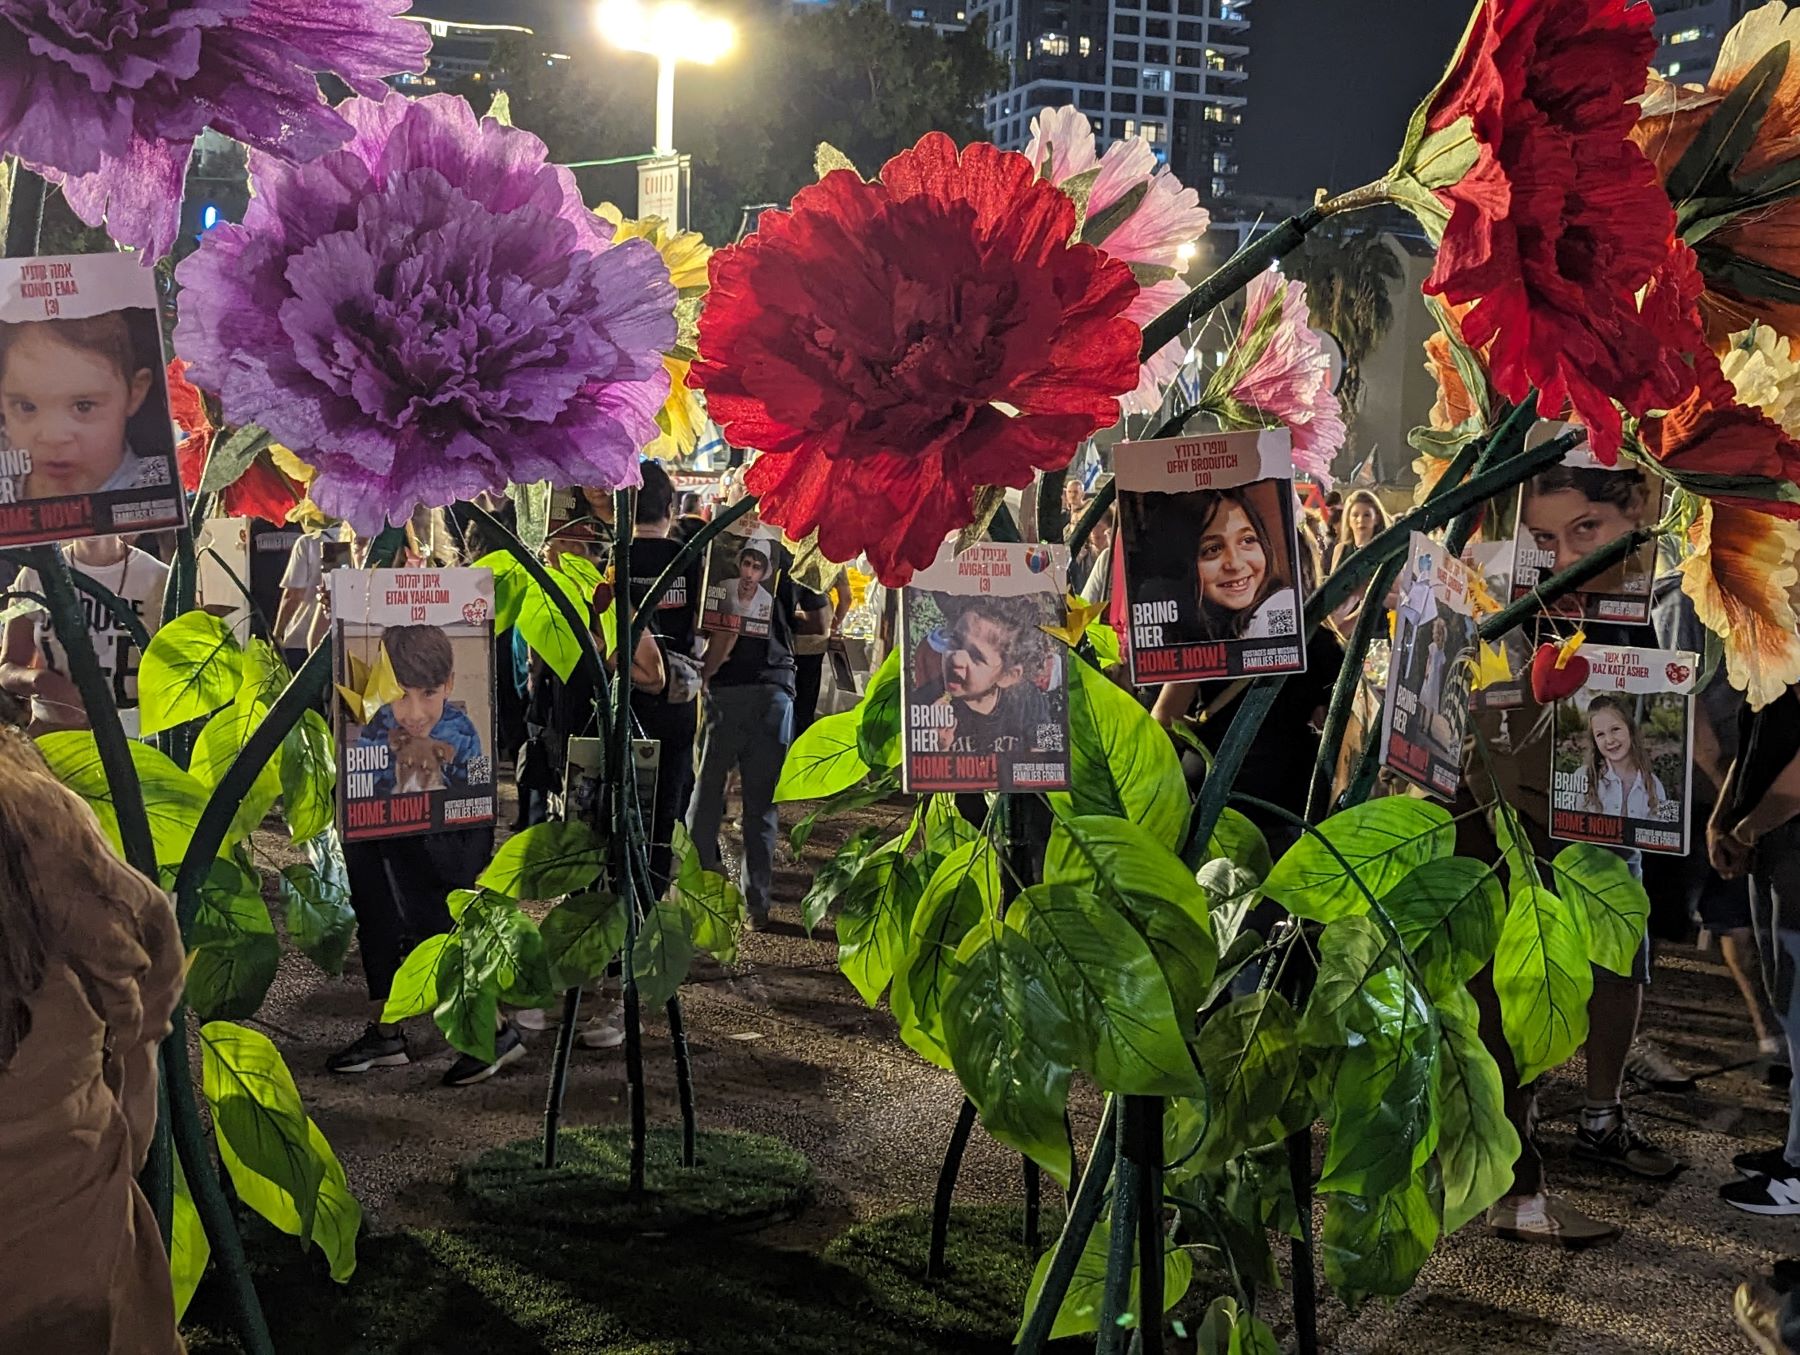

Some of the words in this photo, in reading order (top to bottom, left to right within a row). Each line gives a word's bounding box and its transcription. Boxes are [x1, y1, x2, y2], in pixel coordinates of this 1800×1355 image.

[55, 280, 79, 297] EMA
[45, 298, 59, 316] (3)
[1174, 443, 1200, 459] ברודץ
[1202, 440, 1227, 455] עופרי
[0, 449, 32, 477] ING
[1166, 459, 1188, 474] OFRY
[1191, 454, 1238, 472] BRODUTCH
[1195, 471, 1212, 487] (10)
[0, 507, 33, 532] OME
[980, 547, 1008, 561] אביגיל
[1519, 549, 1556, 568] BRING
[958, 563, 990, 576] AVIGAIL
[992, 563, 1011, 576] IDAN
[1516, 567, 1540, 585] HER
[395, 574, 421, 588] יהלומי
[422, 574, 441, 589] איתן
[979, 577, 991, 592] (3)
[386, 590, 409, 605] EITAN
[410, 589, 449, 604] YAHALOMI
[411, 606, 426, 622] (12)
[1132, 600, 1178, 625] BRING
[1134, 626, 1164, 648] HER
[1137, 649, 1179, 673] HOME
[1182, 643, 1227, 671] NOW!
[1243, 655, 1273, 669] FAMILIES
[1275, 653, 1299, 666] FORUM
[1603, 652, 1620, 663] אשר
[1622, 653, 1630, 665] כץ
[1632, 653, 1640, 665] רז
[1592, 663, 1607, 674] RAZ
[1608, 664, 1626, 676] KATZ
[1627, 666, 1649, 678] ASHER
[1615, 677, 1626, 689] (4)
[1397, 685, 1418, 715] BRING
[911, 704, 954, 727] BRING
[1393, 707, 1408, 735] HER
[911, 728, 939, 752] HER
[347, 745, 389, 772] BRING
[912, 756, 951, 778] HOME
[956, 752, 997, 778] NOW!
[1013, 770, 1041, 782] FAMILIES
[1042, 770, 1065, 782] FORUM
[1554, 771, 1588, 794] BRING
[347, 773, 374, 799] HIM
[1554, 790, 1577, 811] HER
[348, 800, 387, 828] HOME
[391, 792, 431, 823] NOW!
[445, 807, 471, 820] FAMILIES
[472, 804, 492, 817] FORUM
[1554, 811, 1586, 832] HOME
[1589, 815, 1623, 837] NOW!
